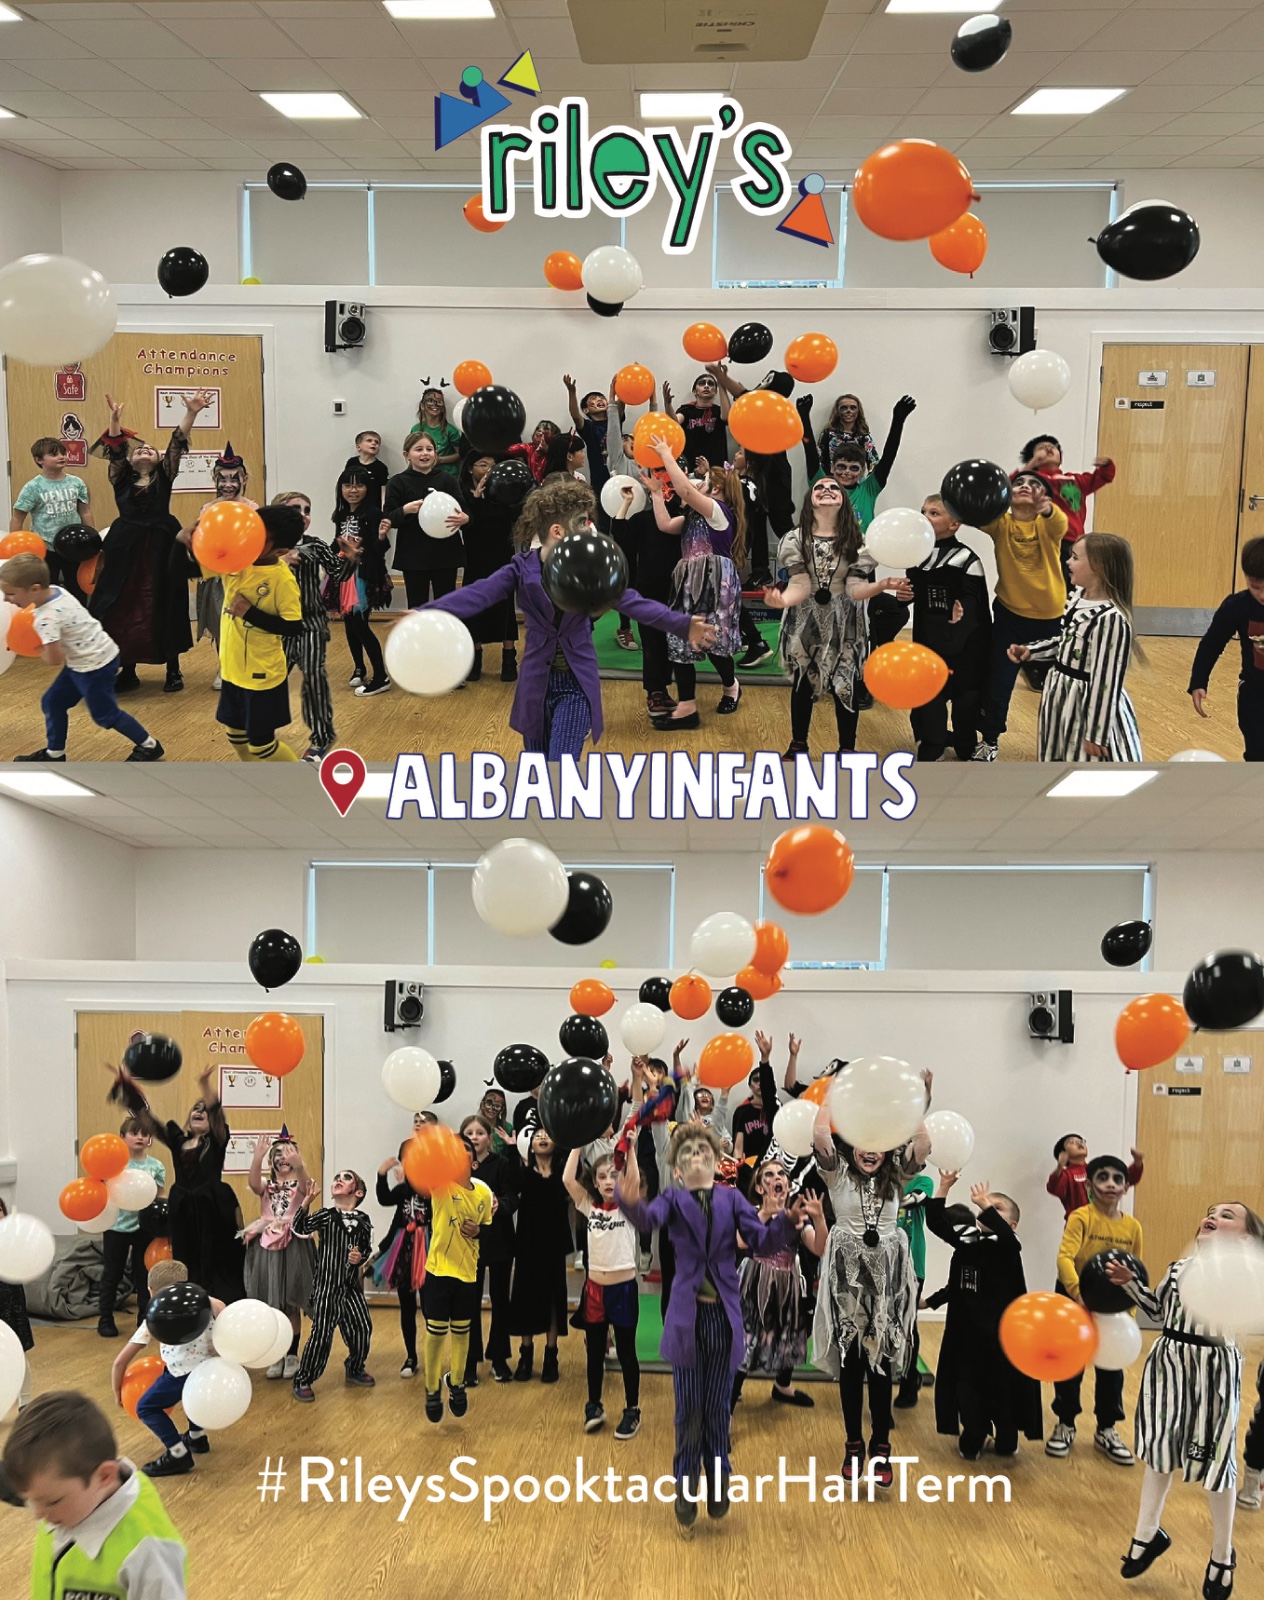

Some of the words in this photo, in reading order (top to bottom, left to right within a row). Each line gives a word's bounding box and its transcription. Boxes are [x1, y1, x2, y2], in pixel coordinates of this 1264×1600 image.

[136, 348, 237, 363] Attendance
[143, 362, 230, 378] Champions
[62, 382, 79, 395] Safe
[66, 450, 80, 462] Kind
